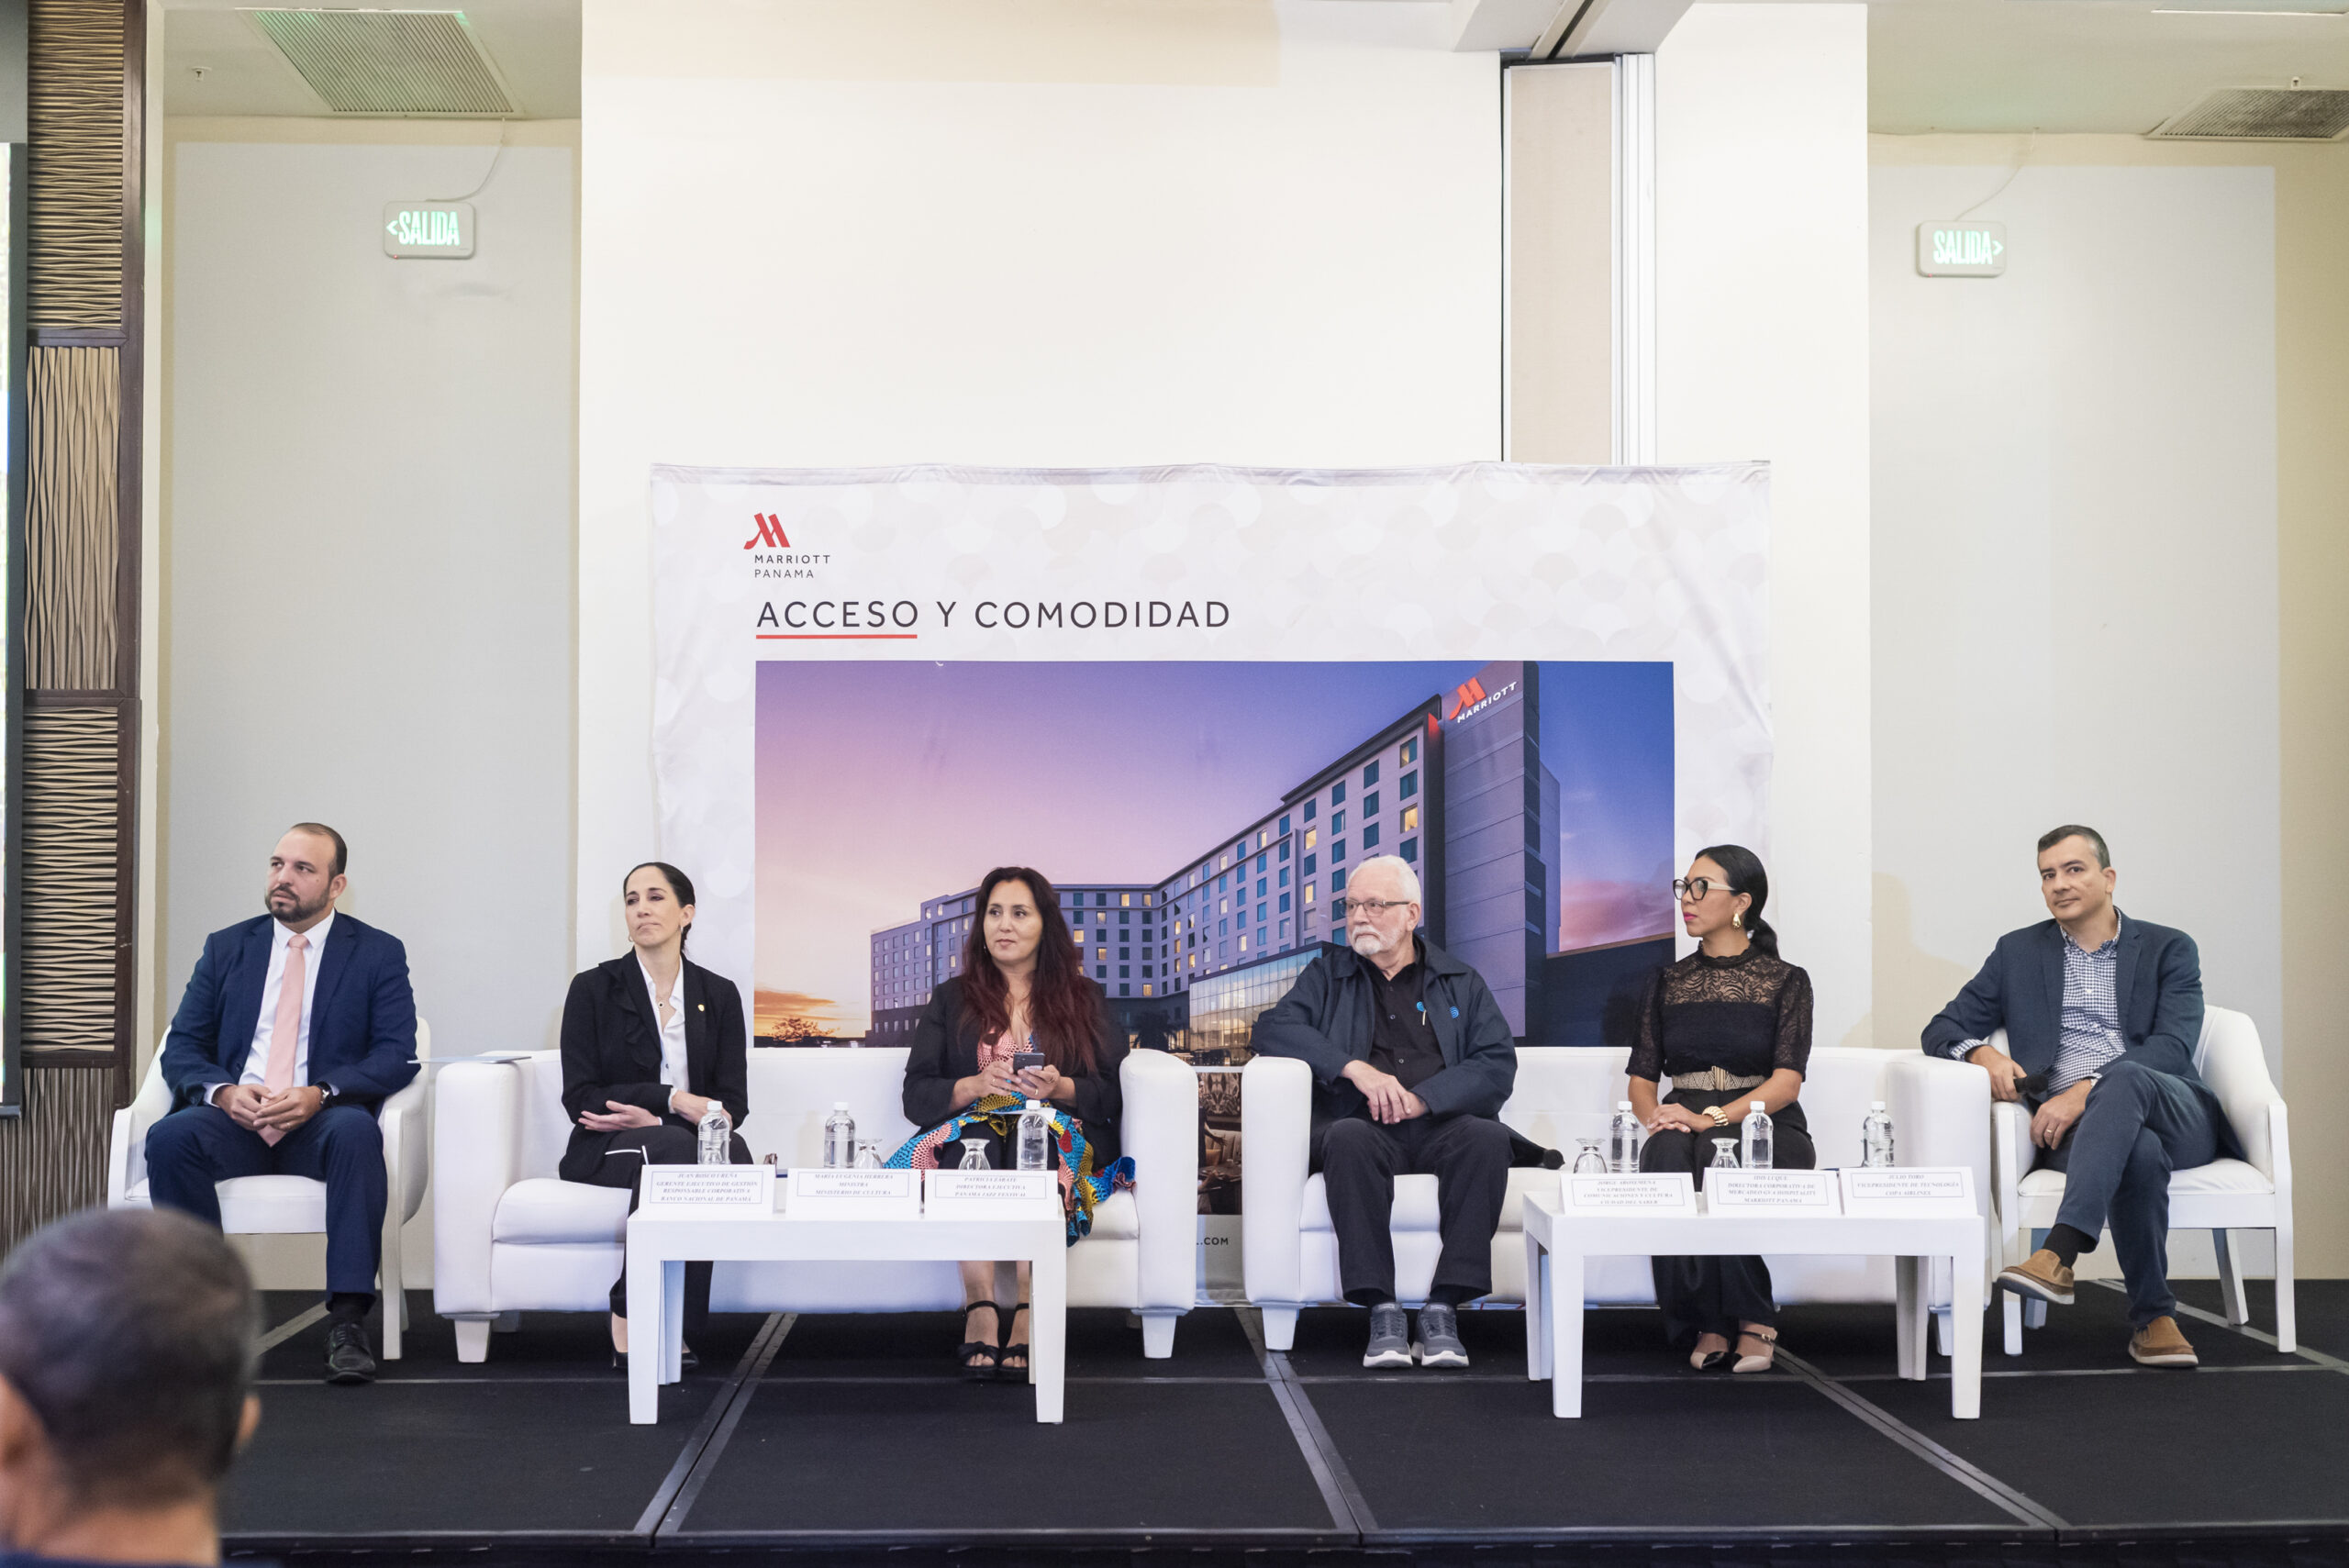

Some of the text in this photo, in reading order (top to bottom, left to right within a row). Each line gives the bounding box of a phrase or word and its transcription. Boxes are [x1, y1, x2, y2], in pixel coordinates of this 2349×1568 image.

[398, 210, 461, 246] SALIDA
[1932, 229, 1993, 264] SALIDA
[753, 554, 831, 564] MARRIOTT
[753, 569, 815, 579] PANAMA
[756, 600, 1230, 628] ACCESO Y COMODIDAD
[1457, 681, 1518, 723] MARRIOTT
